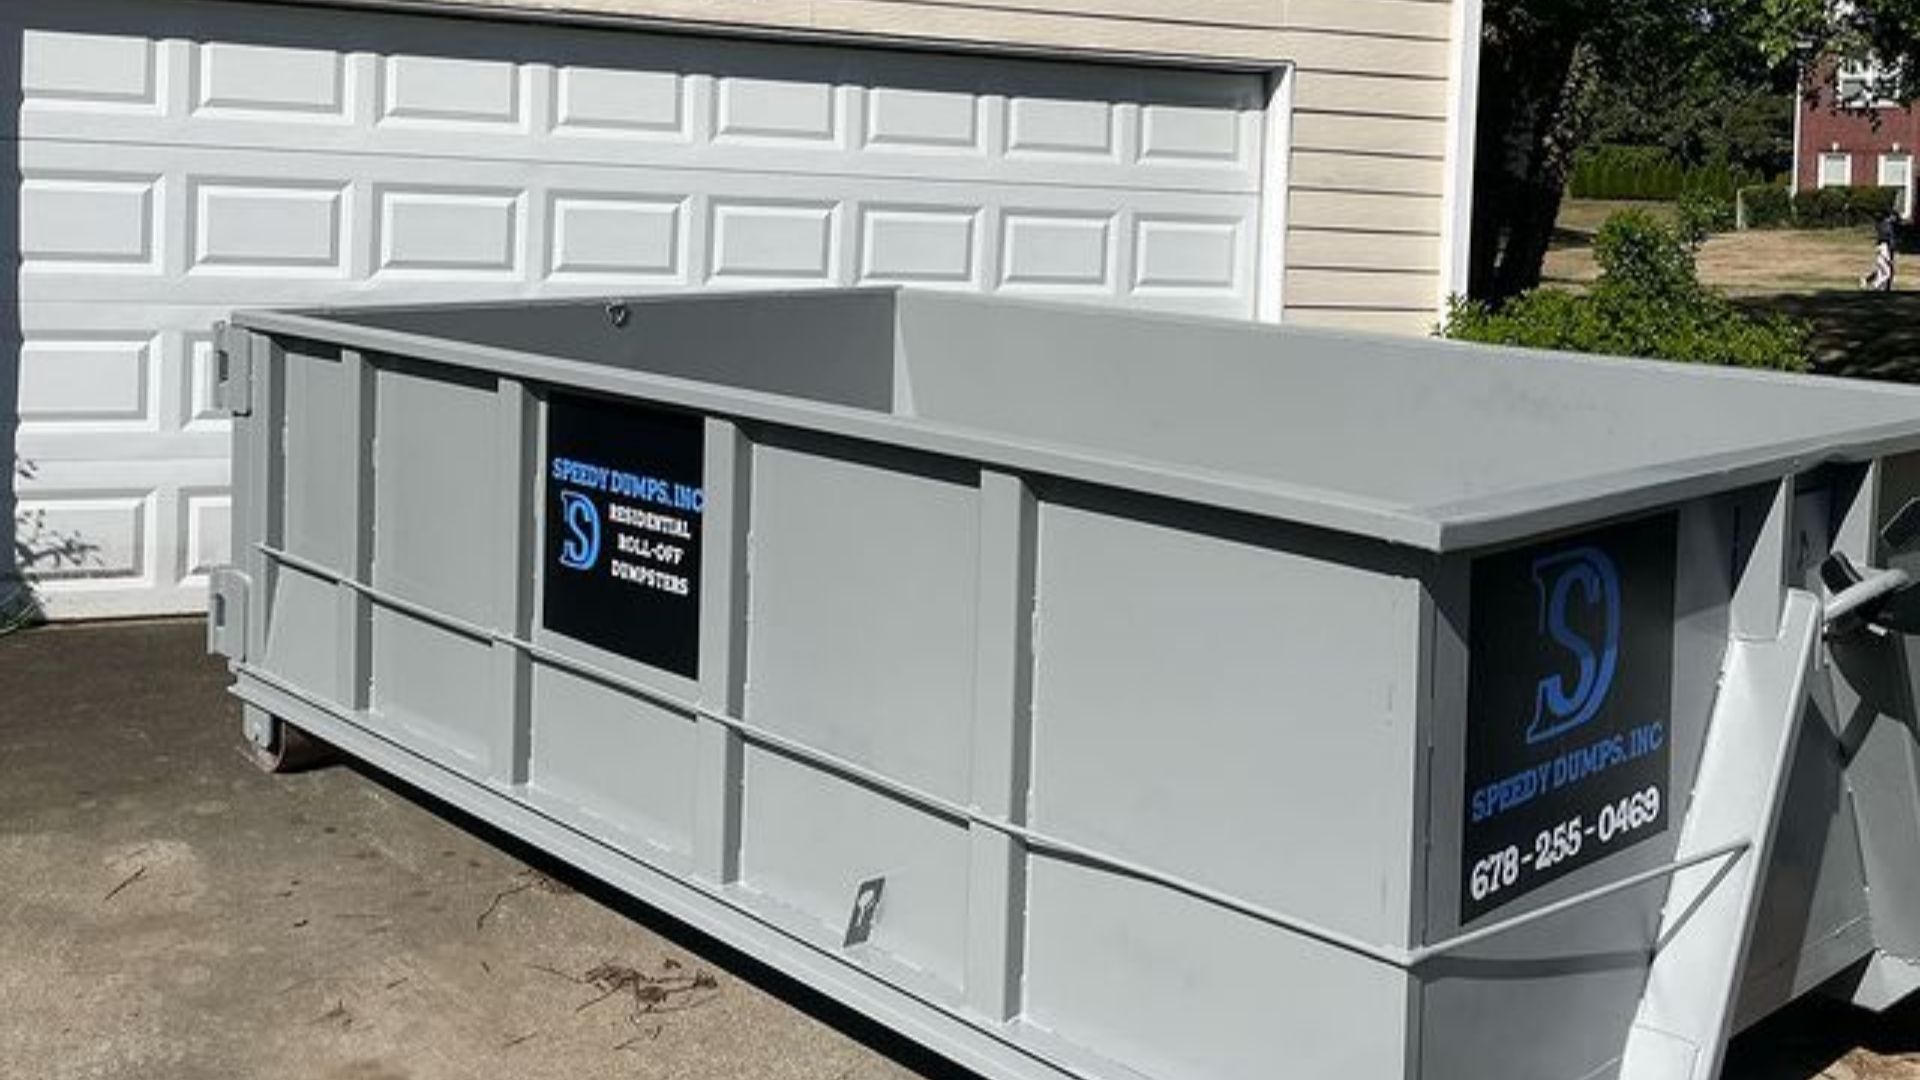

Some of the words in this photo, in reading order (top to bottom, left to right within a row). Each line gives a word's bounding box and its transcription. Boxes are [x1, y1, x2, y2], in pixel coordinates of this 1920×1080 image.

[552, 457, 609, 490] SPEEDY
[674, 484, 707, 513] INC
[609, 503, 691, 540] RESIDENTIAL
[617, 533, 684, 565] ROLL-OFF
[611, 559, 689, 596] DUMPSTERS
[1471, 762, 1552, 821] SPEEDY
[1630, 720, 1664, 759] INC
